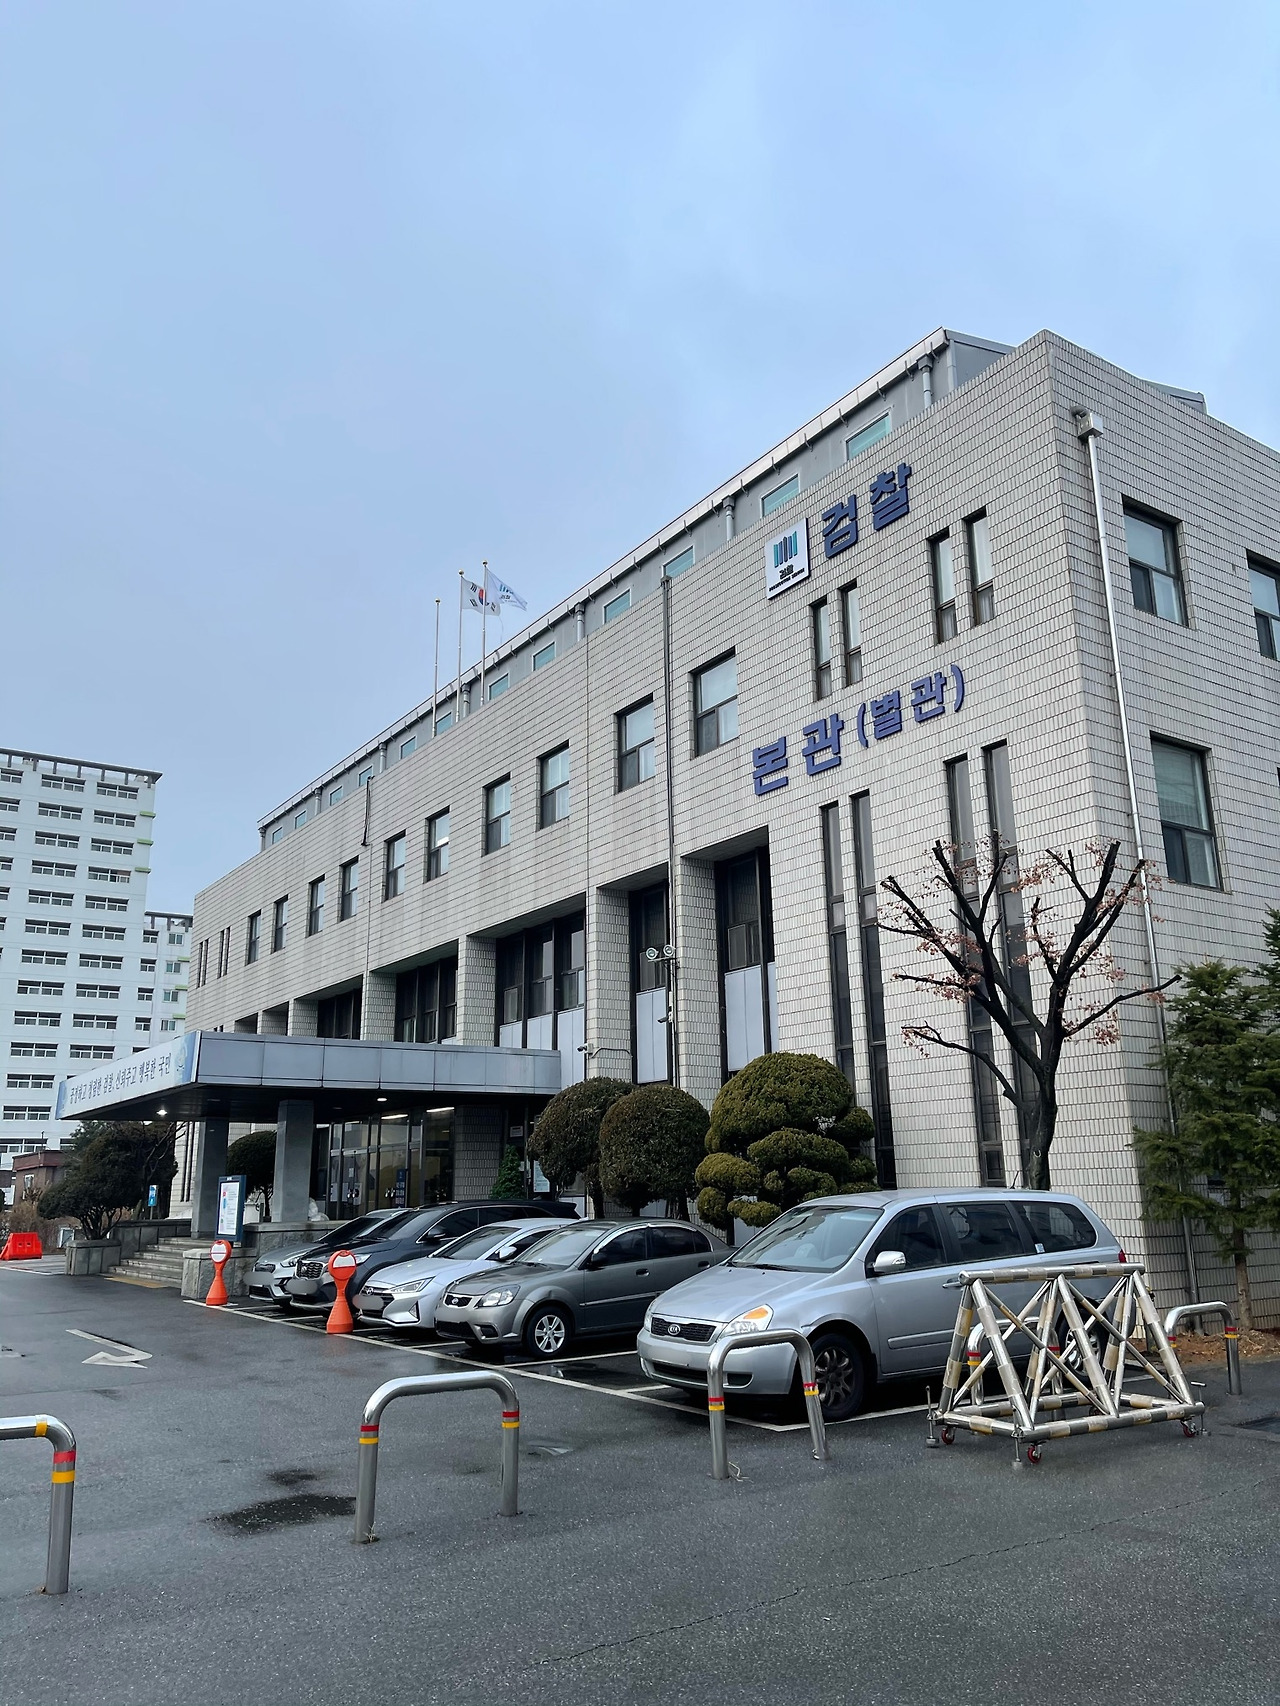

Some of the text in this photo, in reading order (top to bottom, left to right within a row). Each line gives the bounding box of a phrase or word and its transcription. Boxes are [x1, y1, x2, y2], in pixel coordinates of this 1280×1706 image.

[822, 462, 912, 559] 검찰
[139, 1058, 157, 1084] 행복한
[158, 1052, 172, 1077] 국민
